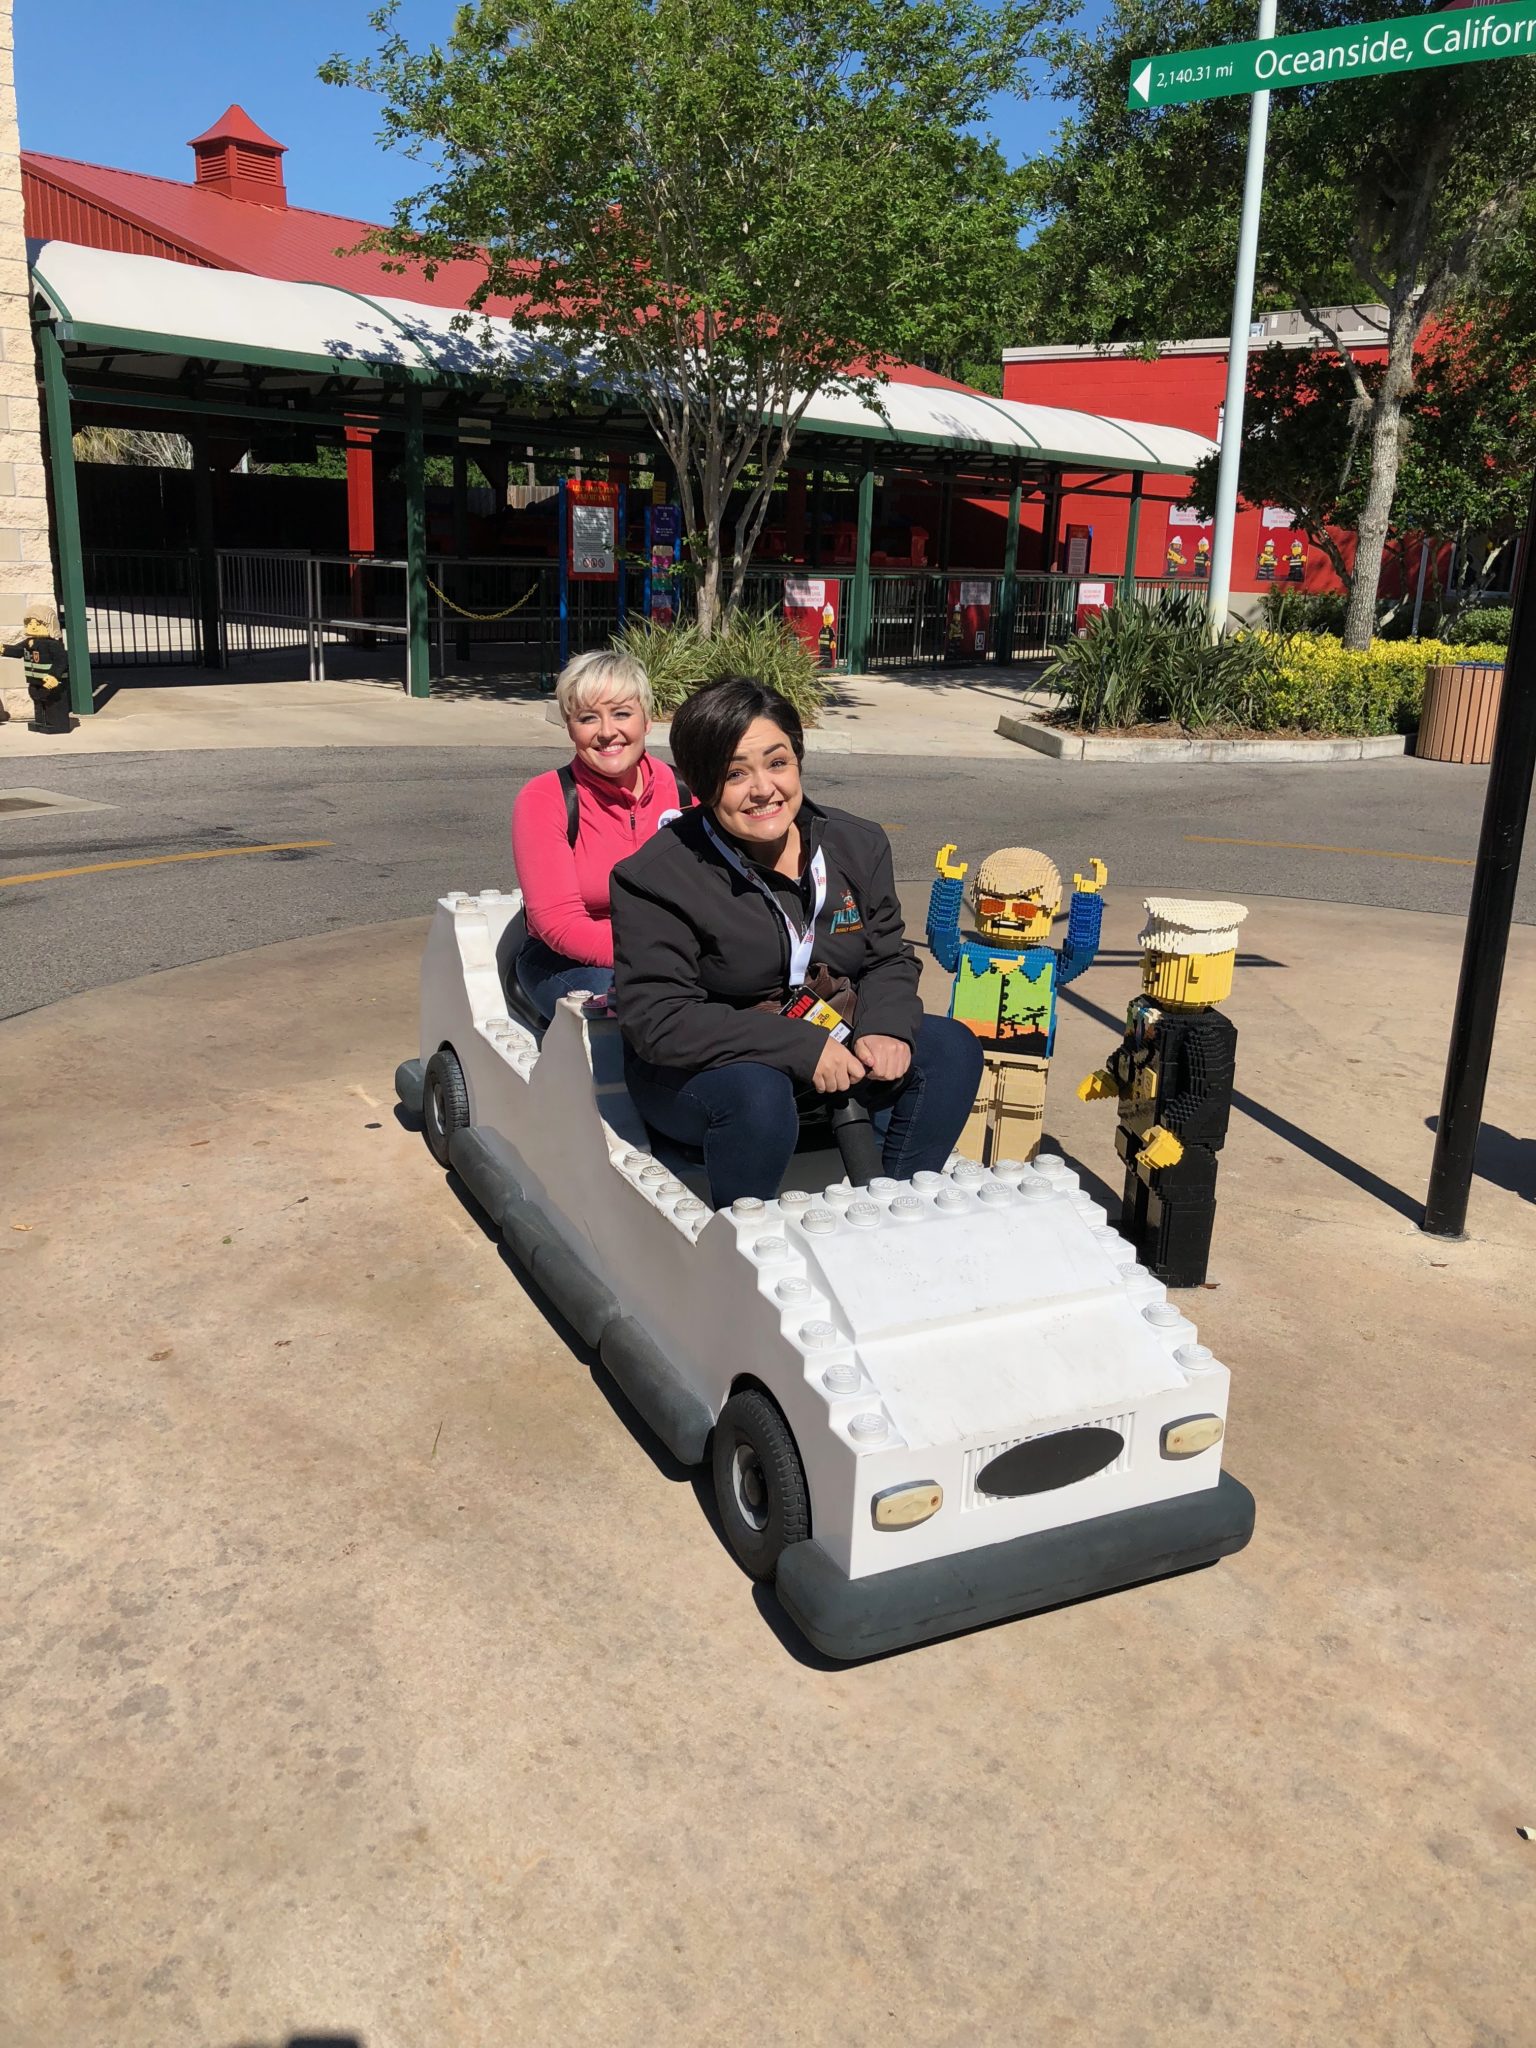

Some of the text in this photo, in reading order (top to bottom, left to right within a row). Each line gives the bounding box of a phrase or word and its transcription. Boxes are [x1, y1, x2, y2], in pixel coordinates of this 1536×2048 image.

[1156, 65, 1211, 88] 2,140.31
[1215, 61, 1234, 78] mi
[1255, 32, 1414, 79] Oceanside,
[786, 994, 815, 1019] EDIA
